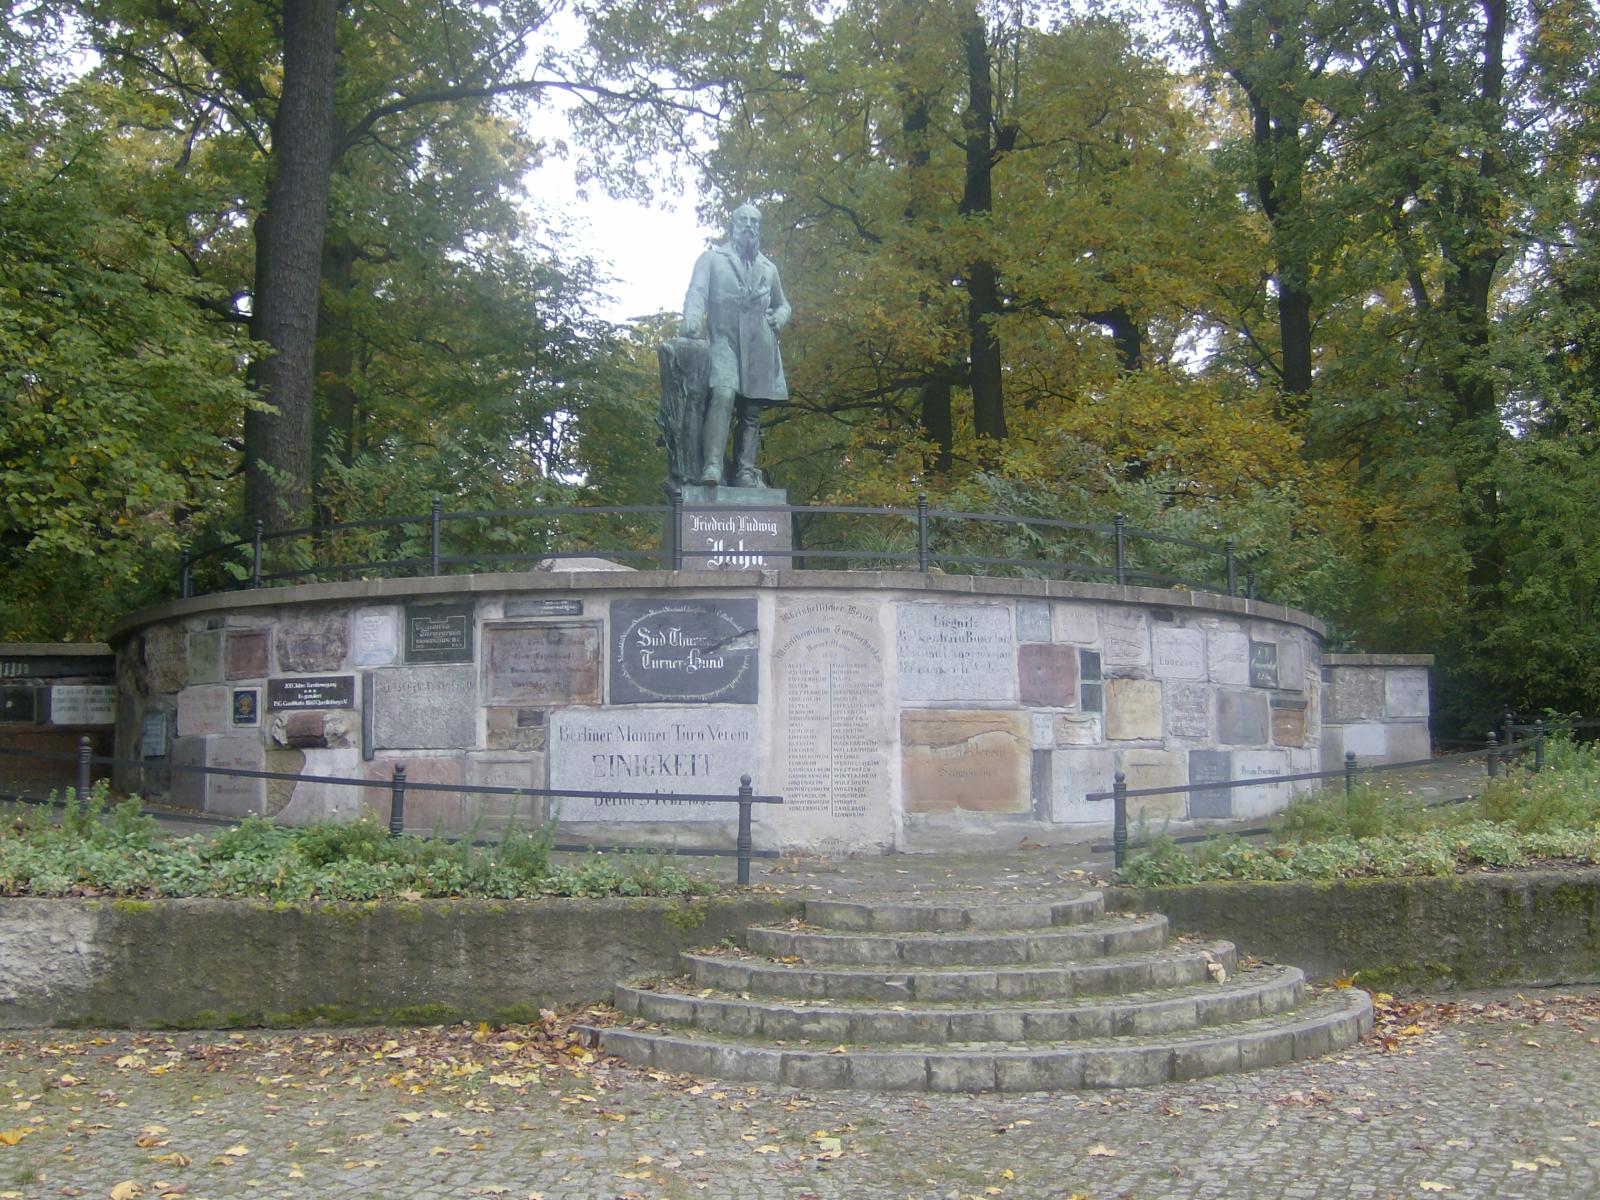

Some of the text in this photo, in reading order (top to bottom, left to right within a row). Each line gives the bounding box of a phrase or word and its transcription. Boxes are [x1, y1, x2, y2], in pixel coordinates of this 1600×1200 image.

[690, 515, 777, 536] Friedrich Ludwig
[559, 726, 612, 743] Berliner
[707, 724, 750, 743] Verein
[592, 754, 714, 778] EINIGKEIT
